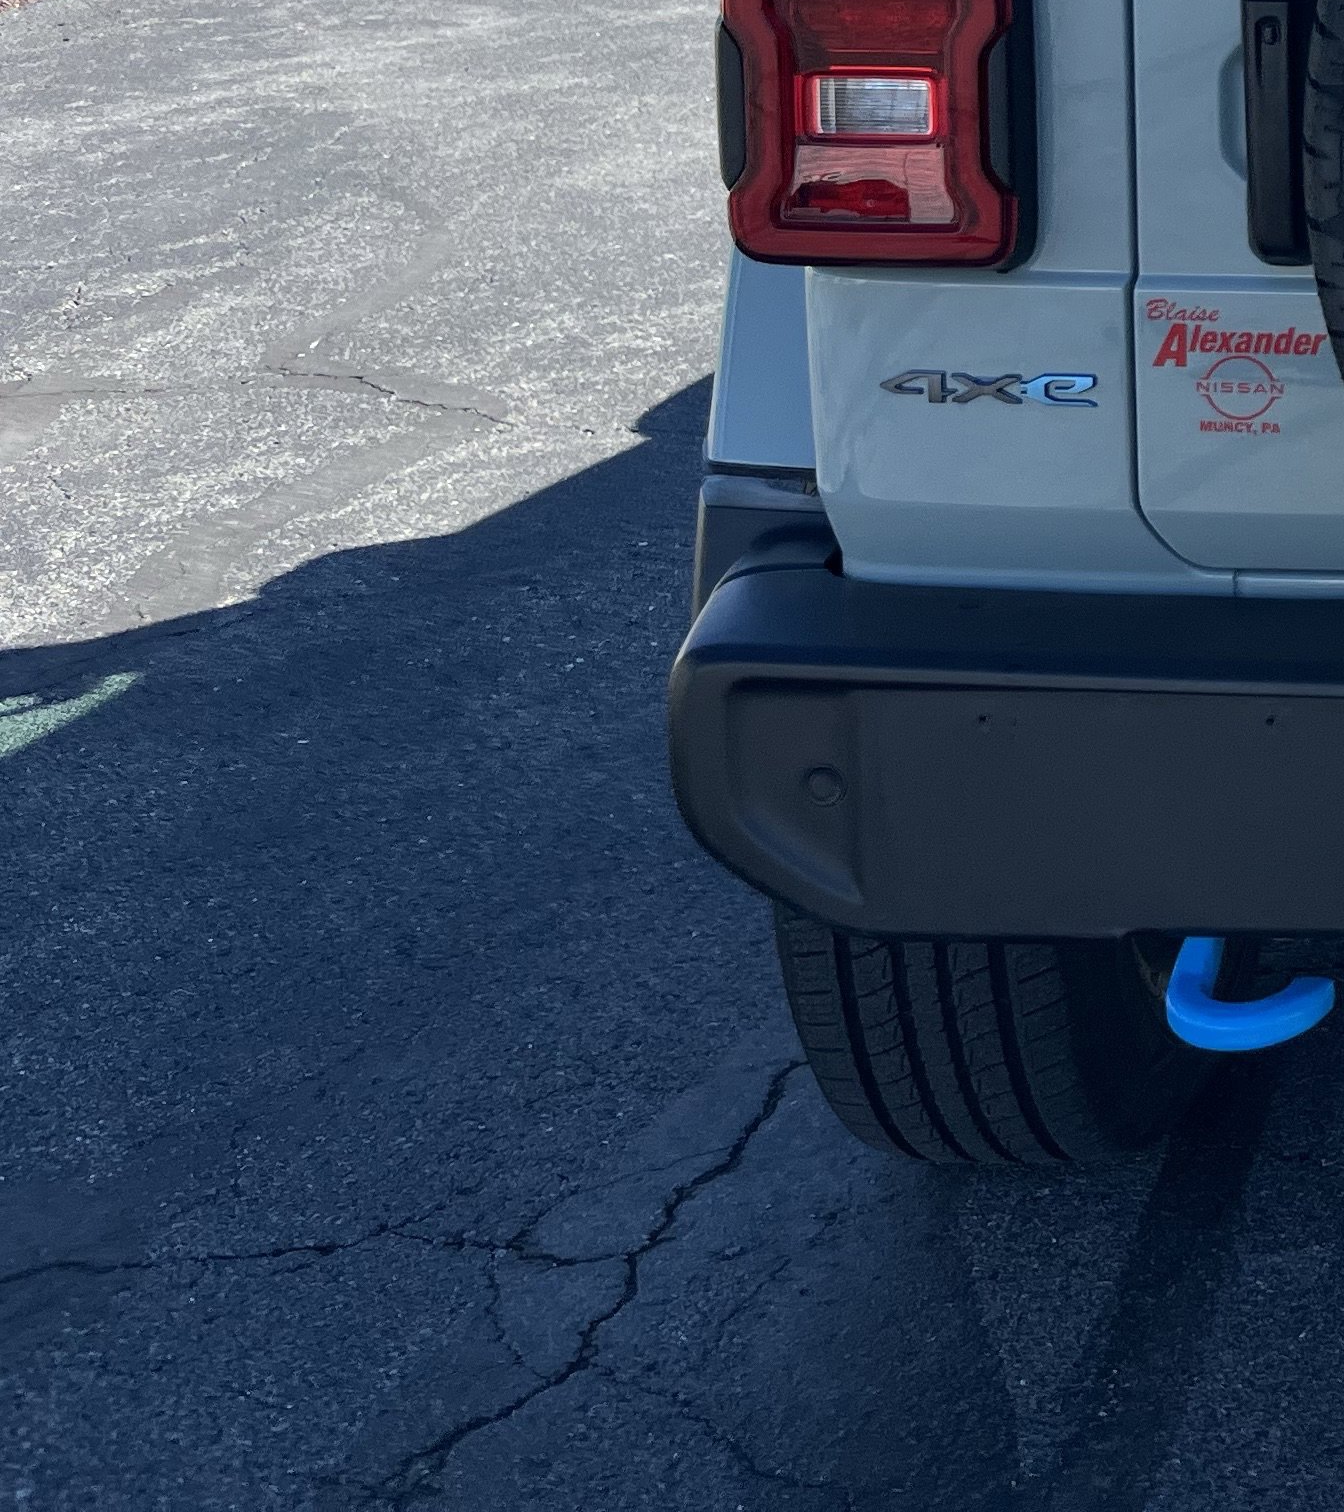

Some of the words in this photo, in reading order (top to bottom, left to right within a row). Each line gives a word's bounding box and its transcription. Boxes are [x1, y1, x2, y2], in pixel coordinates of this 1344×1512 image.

[1145, 298, 1221, 322] Blaise
[1152, 323, 1328, 367] Alexander
[1196, 380, 1285, 394] NISSAN
[1261, 422, 1281, 434] PA
